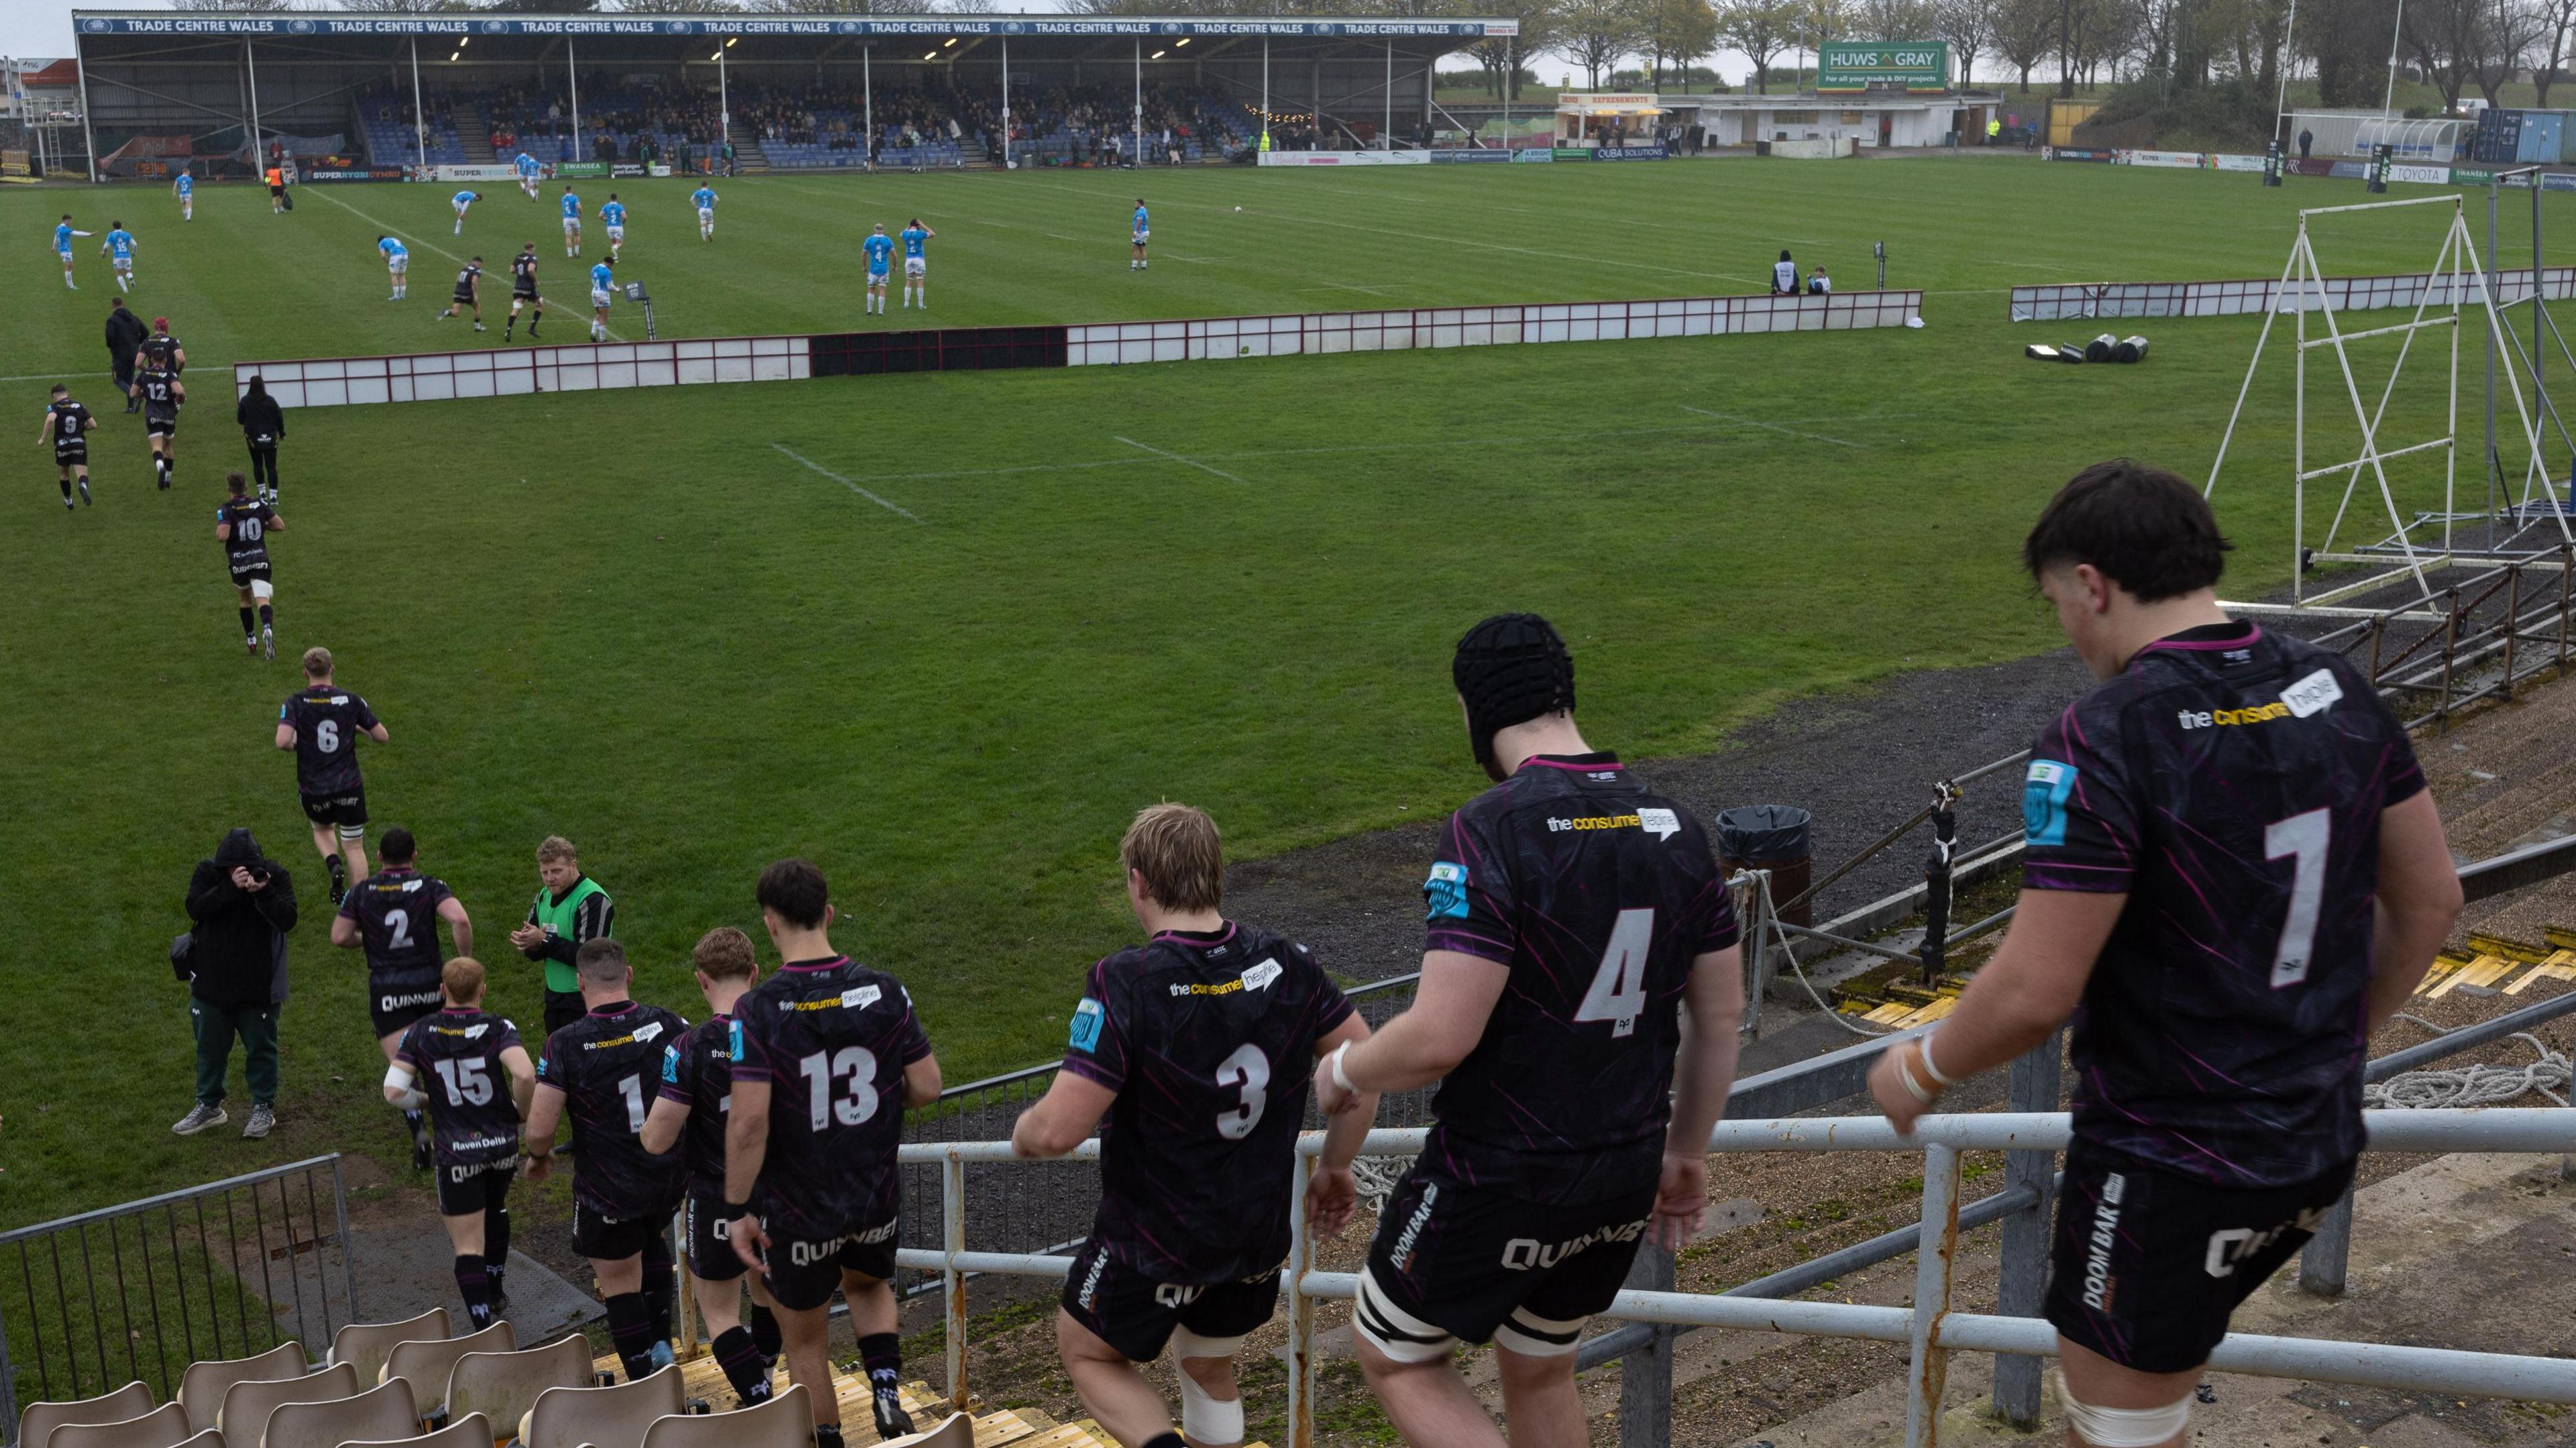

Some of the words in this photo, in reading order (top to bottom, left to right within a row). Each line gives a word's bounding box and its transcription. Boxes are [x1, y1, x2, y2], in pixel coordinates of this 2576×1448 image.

[127, 20, 172, 32] TRADE
[176, 20, 226, 32] CENTRE
[229, 20, 274, 32] WALES
[329, 21, 372, 32] TRADE
[375, 21, 423, 32] CENTRE
[426, 21, 469, 32] WALES
[521, 22, 562, 32] TRADE
[565, 22, 610, 32] CENTRE
[613, 22, 654, 32] WALES
[704, 23, 743, 32] TRADE
[745, 23, 792, 32] CENTRE
[794, 23, 830, 32] WALES
[869, 23, 906, 33] TRADE
[910, 23, 951, 33] CENTRE
[953, 23, 990, 33] WALES
[1035, 23, 1071, 34] TRADE
[1073, 23, 1114, 34] CENTRE
[1116, 23, 1150, 34] WALES
[1193, 23, 1227, 34] TRADE
[1230, 23, 1267, 34] CENTRE
[1270, 23, 1303, 34] WALES
[1344, 24, 1377, 34] TRADE
[1379, 24, 1415, 34] CENTRE
[1417, 24, 1449, 34] WALES
[1830, 53, 1878, 66] HUWS
[1895, 53, 1935, 66] GRAY
[313, 170, 400, 179] SUPERRYGBICYMRU
[2398, 168, 2439, 181] TOYOTA
[147, 383, 168, 400] 12
[65, 415, 76, 434] 9
[237, 517, 262, 541] 10
[2178, 708, 2213, 730] the
[317, 720, 339, 753] 6
[1547, 816, 1573, 832] the
[384, 909, 415, 950] 2
[1572, 907, 1656, 1040] 4
[1170, 983, 1190, 997] the
[779, 1000, 794, 1011] the
[794, 997, 841, 1011] consumer
[584, 1042, 596, 1050] the
[596, 1035, 634, 1048] consumer
[712, 1049, 725, 1058] the
[434, 1056, 493, 1107] 15
[800, 1045, 879, 1133] 13
[1216, 1043, 1270, 1139] 3
[618, 1073, 645, 1133] 1
[453, 1139, 482, 1152] Raven
[482, 1135, 507, 1148] Delta
[2092, 1205, 2121, 1249] BAR
[1390, 1225, 1418, 1270] DOOM
[1409, 1201, 1433, 1233] BAR
[2082, 1245, 2111, 1311] DOOM
